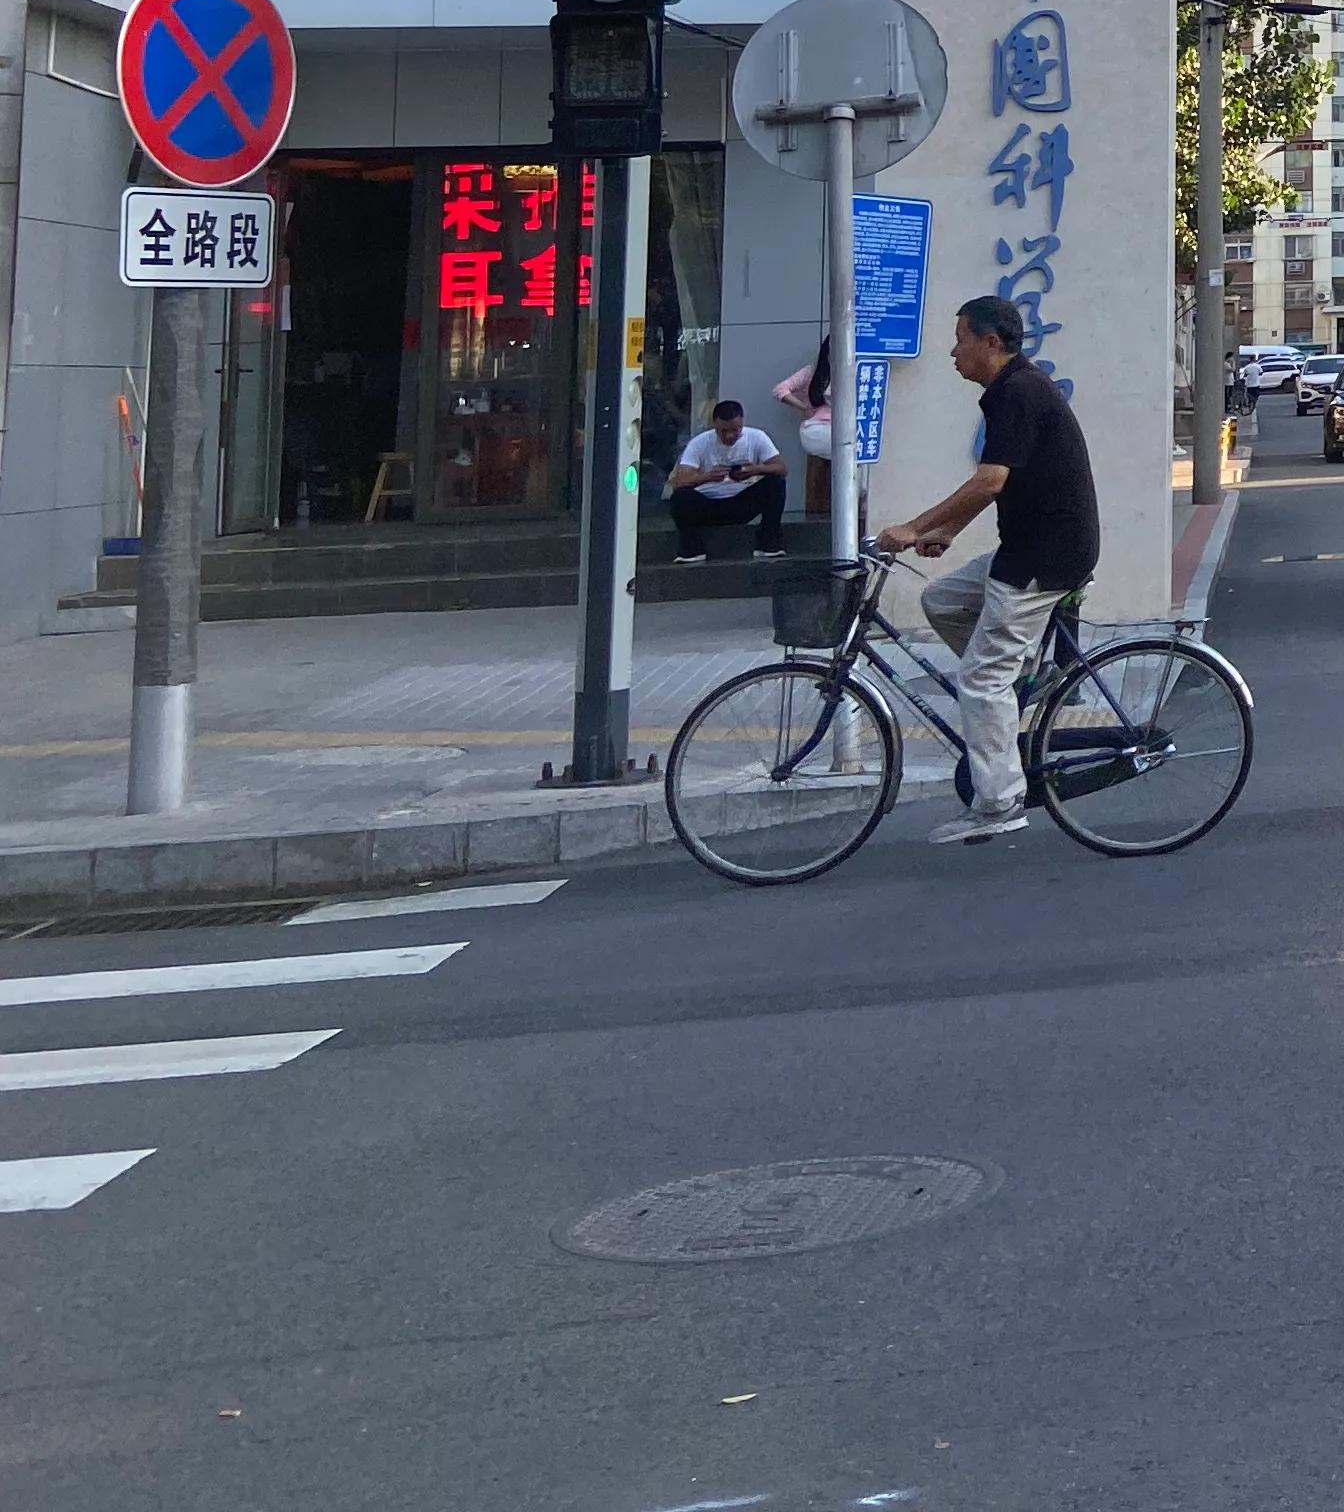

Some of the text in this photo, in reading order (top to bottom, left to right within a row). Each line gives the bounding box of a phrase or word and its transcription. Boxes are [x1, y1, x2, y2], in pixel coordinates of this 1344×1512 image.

[138, 207, 260, 269] 全路段
[866, 365, 885, 457] 非本小区车
